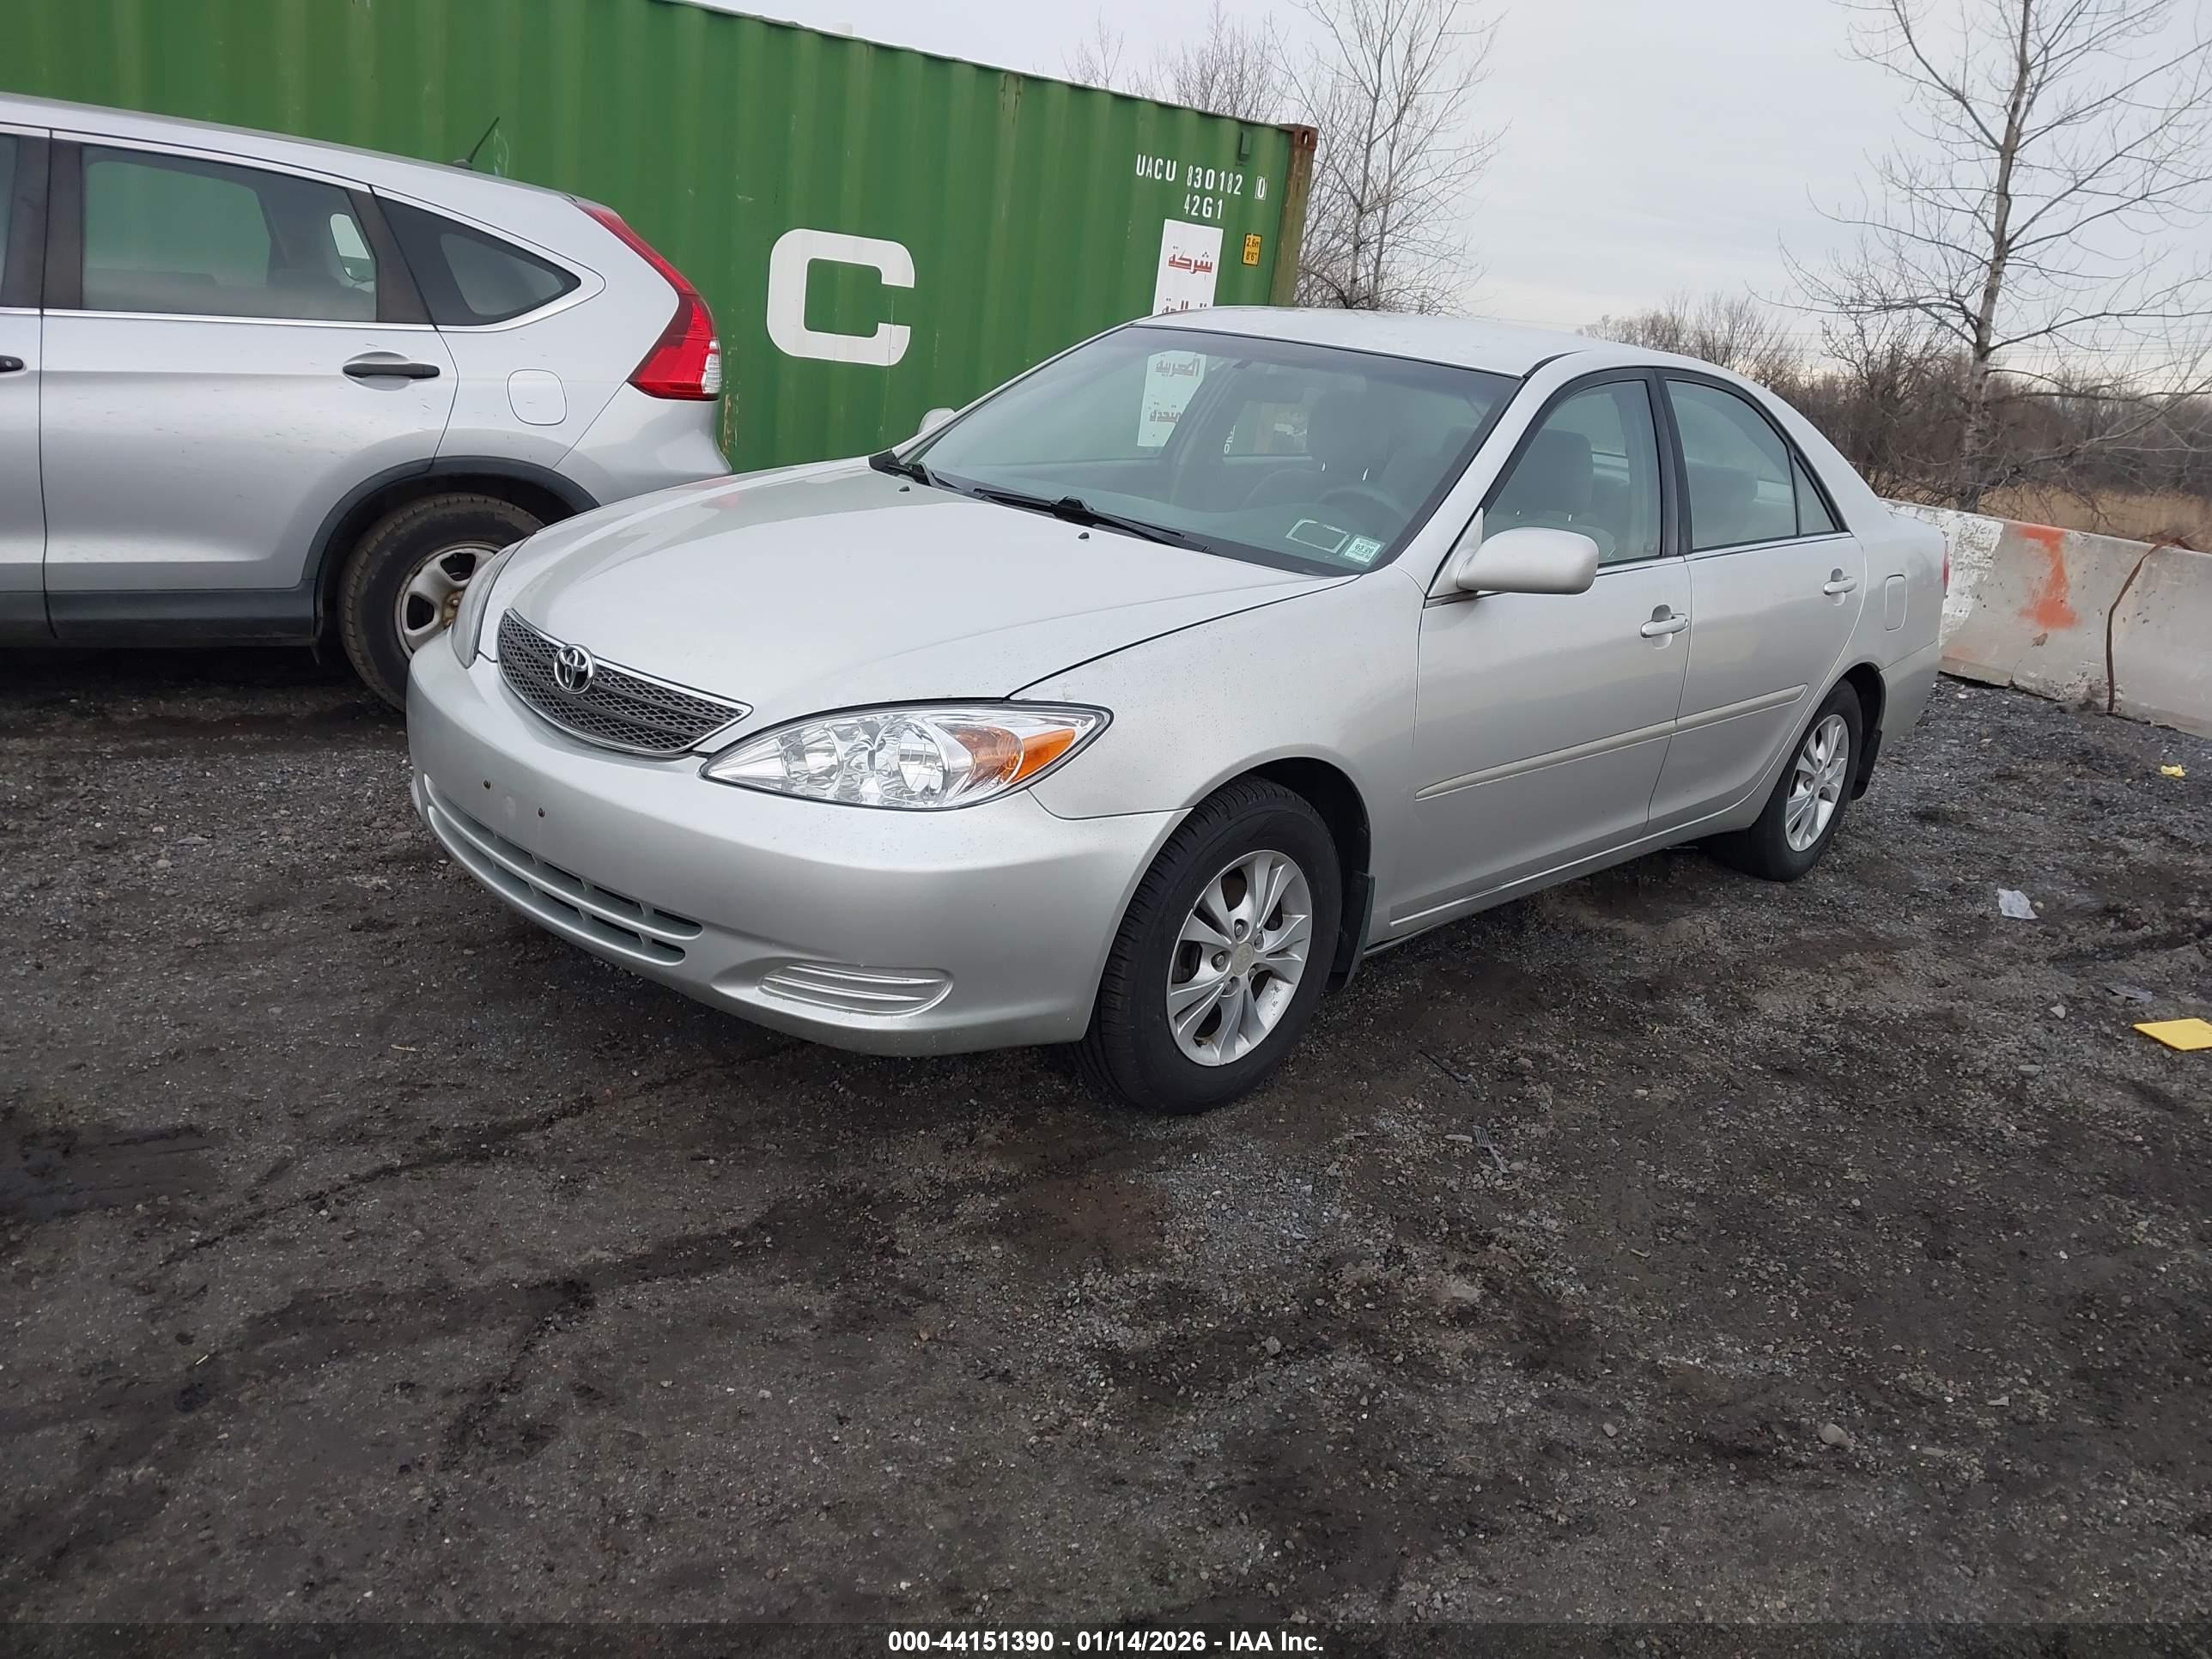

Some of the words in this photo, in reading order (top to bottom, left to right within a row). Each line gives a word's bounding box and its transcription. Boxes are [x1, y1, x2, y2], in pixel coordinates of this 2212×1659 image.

[1135, 154, 1177, 182] UACU
[1187, 165, 1243, 196] 830182
[1183, 193, 1224, 220] 42G1
[1168, 246, 1213, 275] شركة
[767, 228, 915, 367] C
[1155, 354, 1200, 377] العربية
